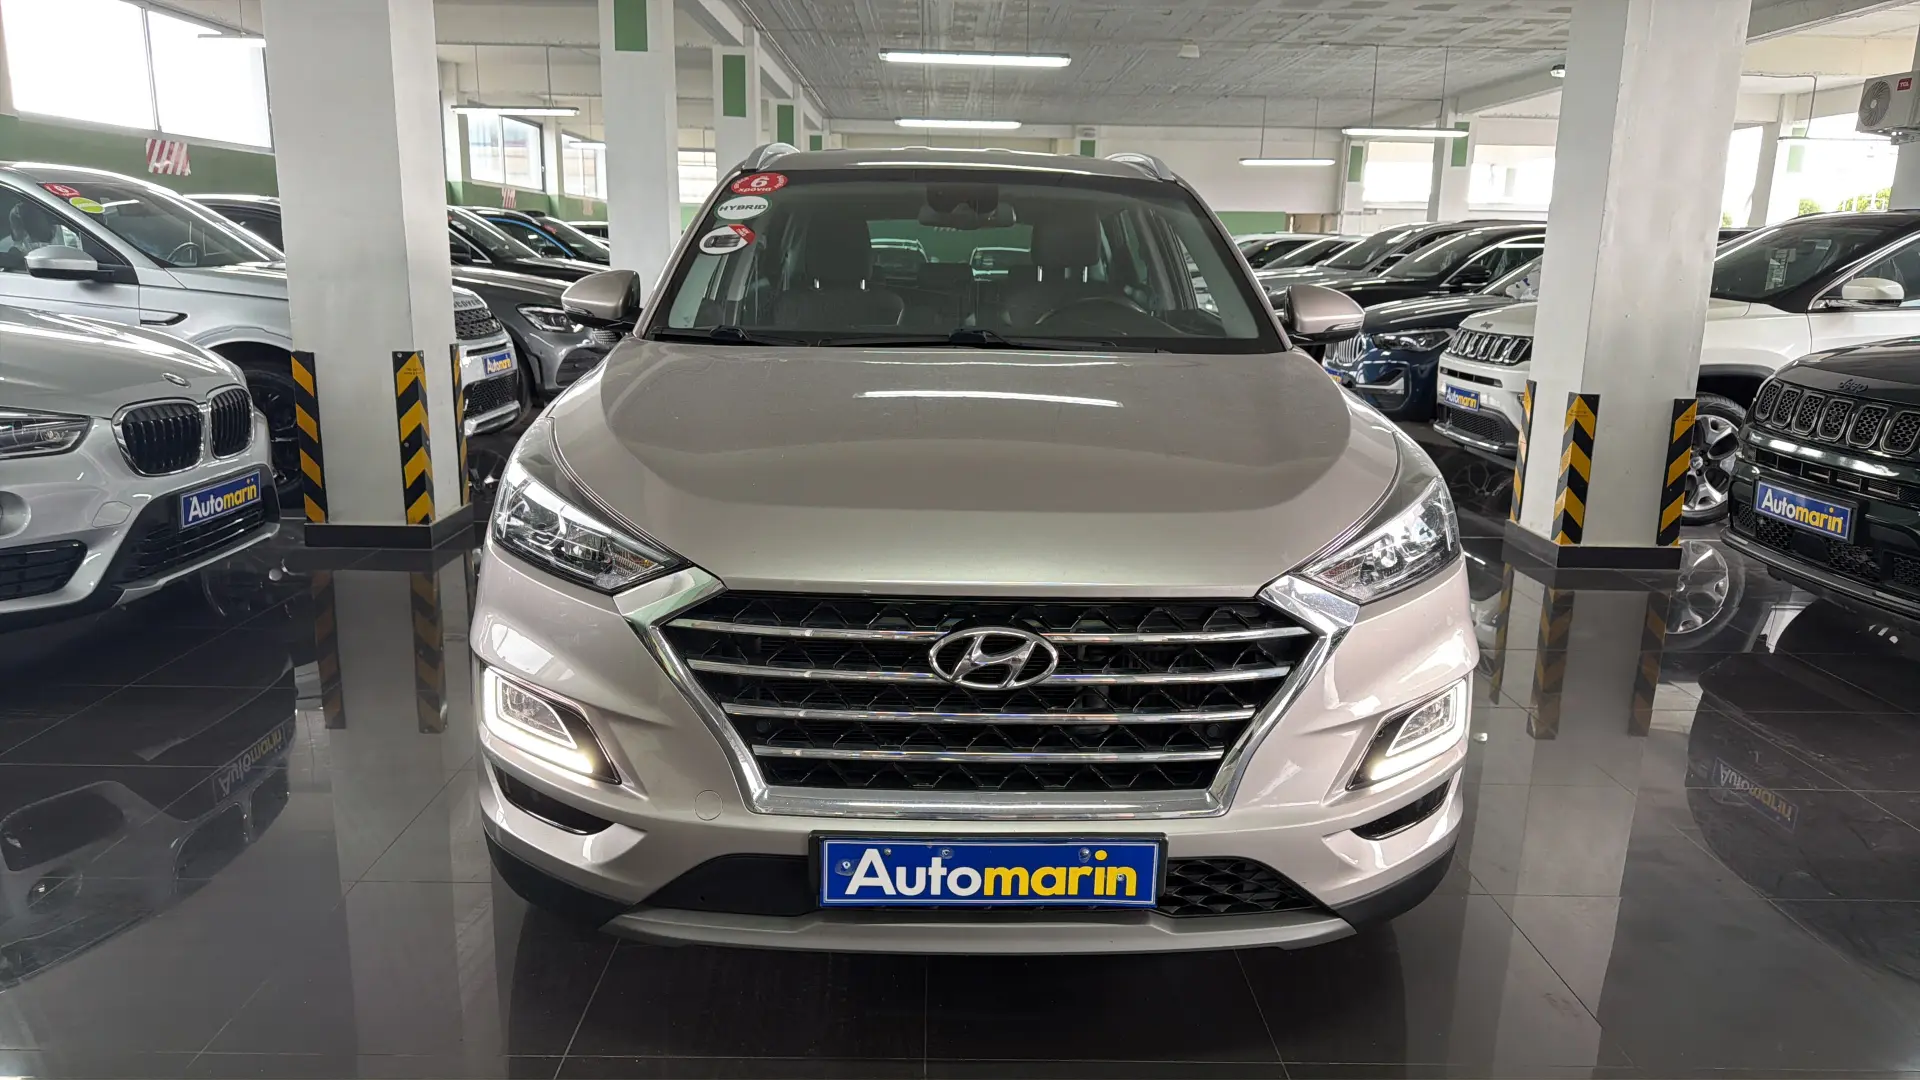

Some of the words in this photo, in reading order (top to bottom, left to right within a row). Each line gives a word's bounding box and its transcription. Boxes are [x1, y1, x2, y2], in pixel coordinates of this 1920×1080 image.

[750, 177, 770, 188] 6
[719, 204, 767, 212] HYBRID
[1839, 378, 1868, 393] Jeep
[188, 479, 257, 522] Automarin
[1761, 488, 1844, 534] Automarin
[844, 848, 1138, 897] Automarin
